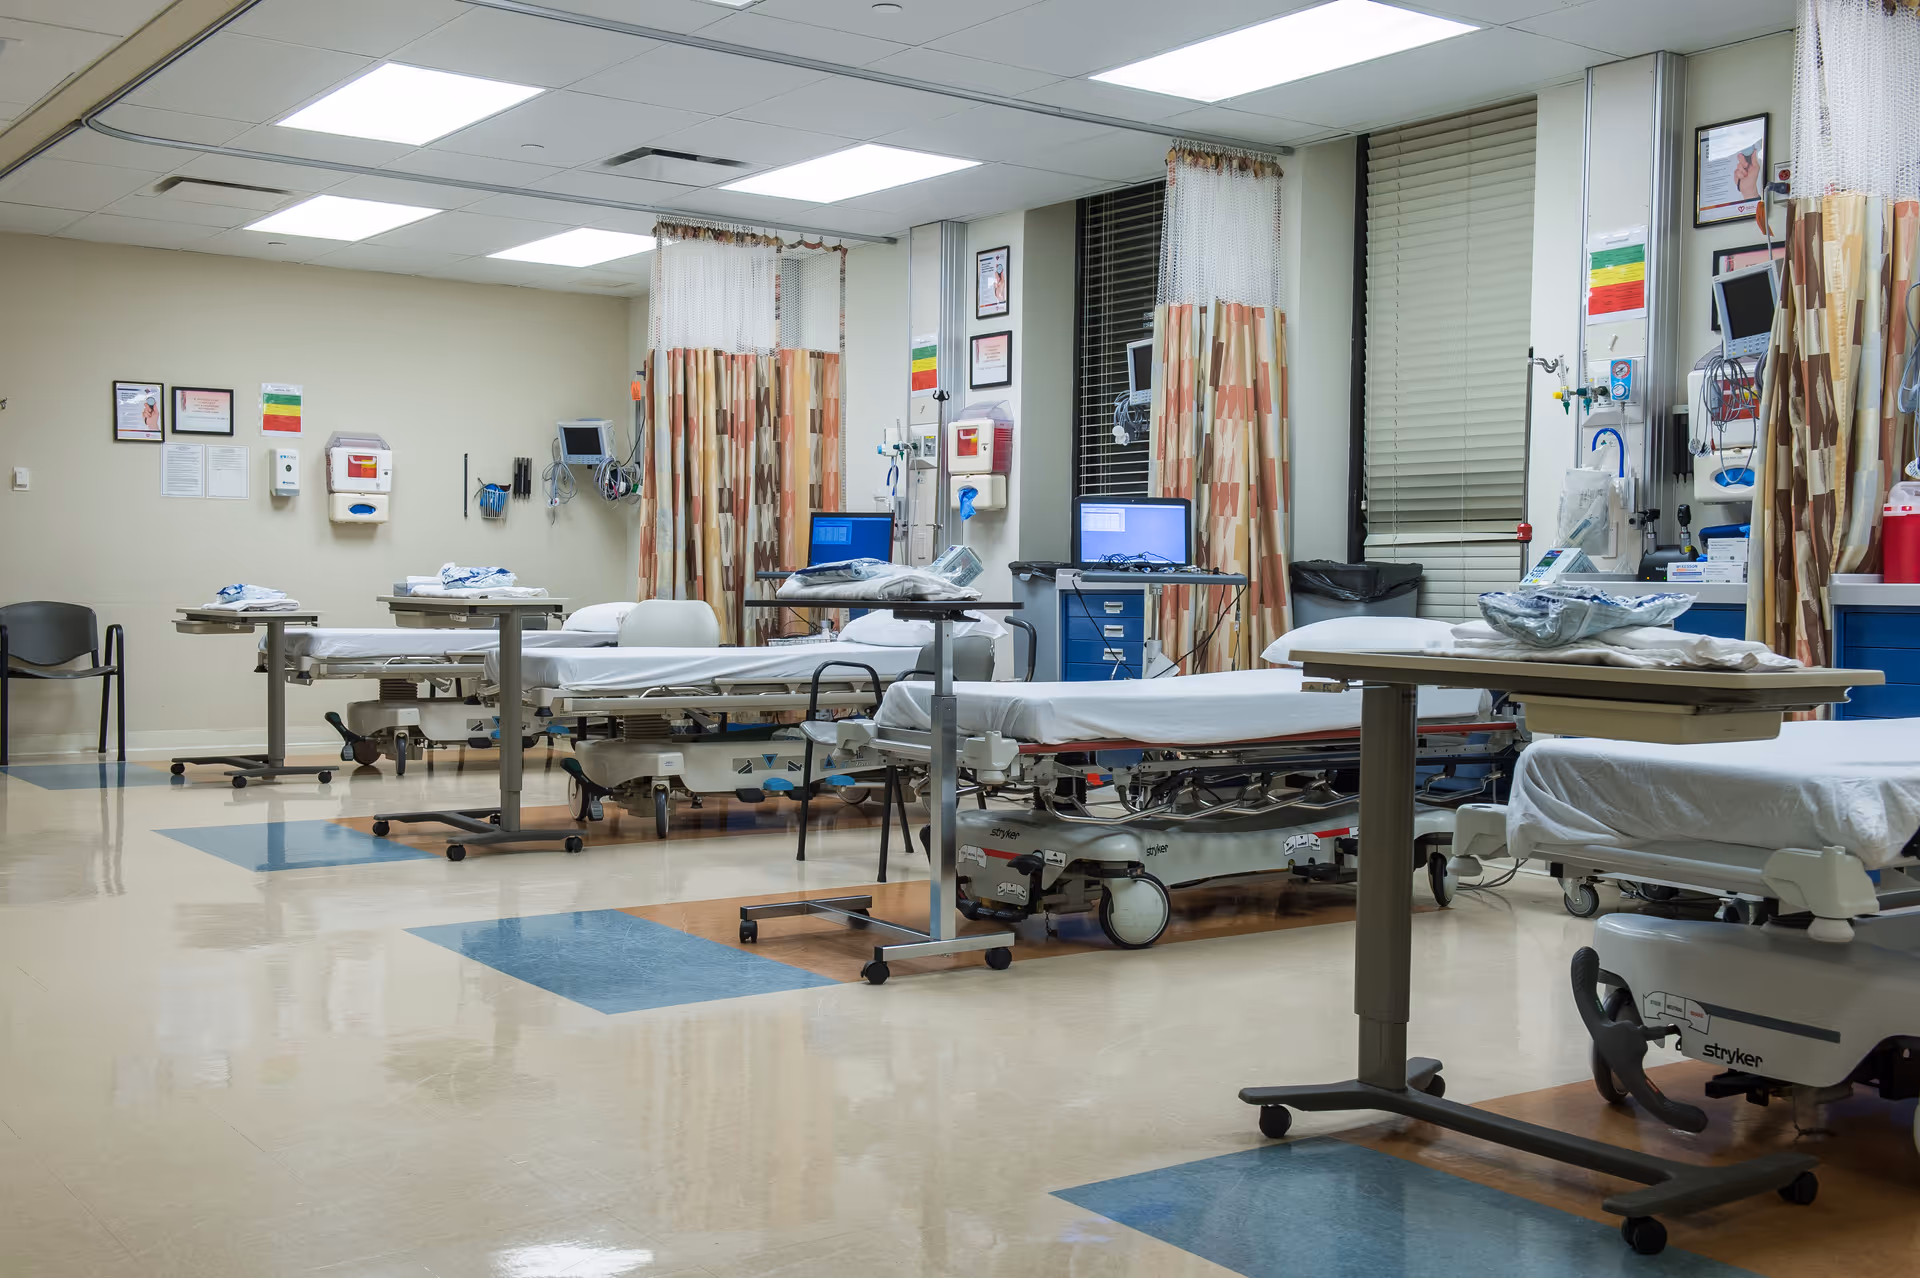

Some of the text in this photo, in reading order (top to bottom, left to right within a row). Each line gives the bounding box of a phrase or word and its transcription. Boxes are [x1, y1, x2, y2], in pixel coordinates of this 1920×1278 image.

[990, 827, 1020, 841] stryker
[1146, 843, 1169, 857] stryker
[1702, 1043, 1763, 1068] stryker
